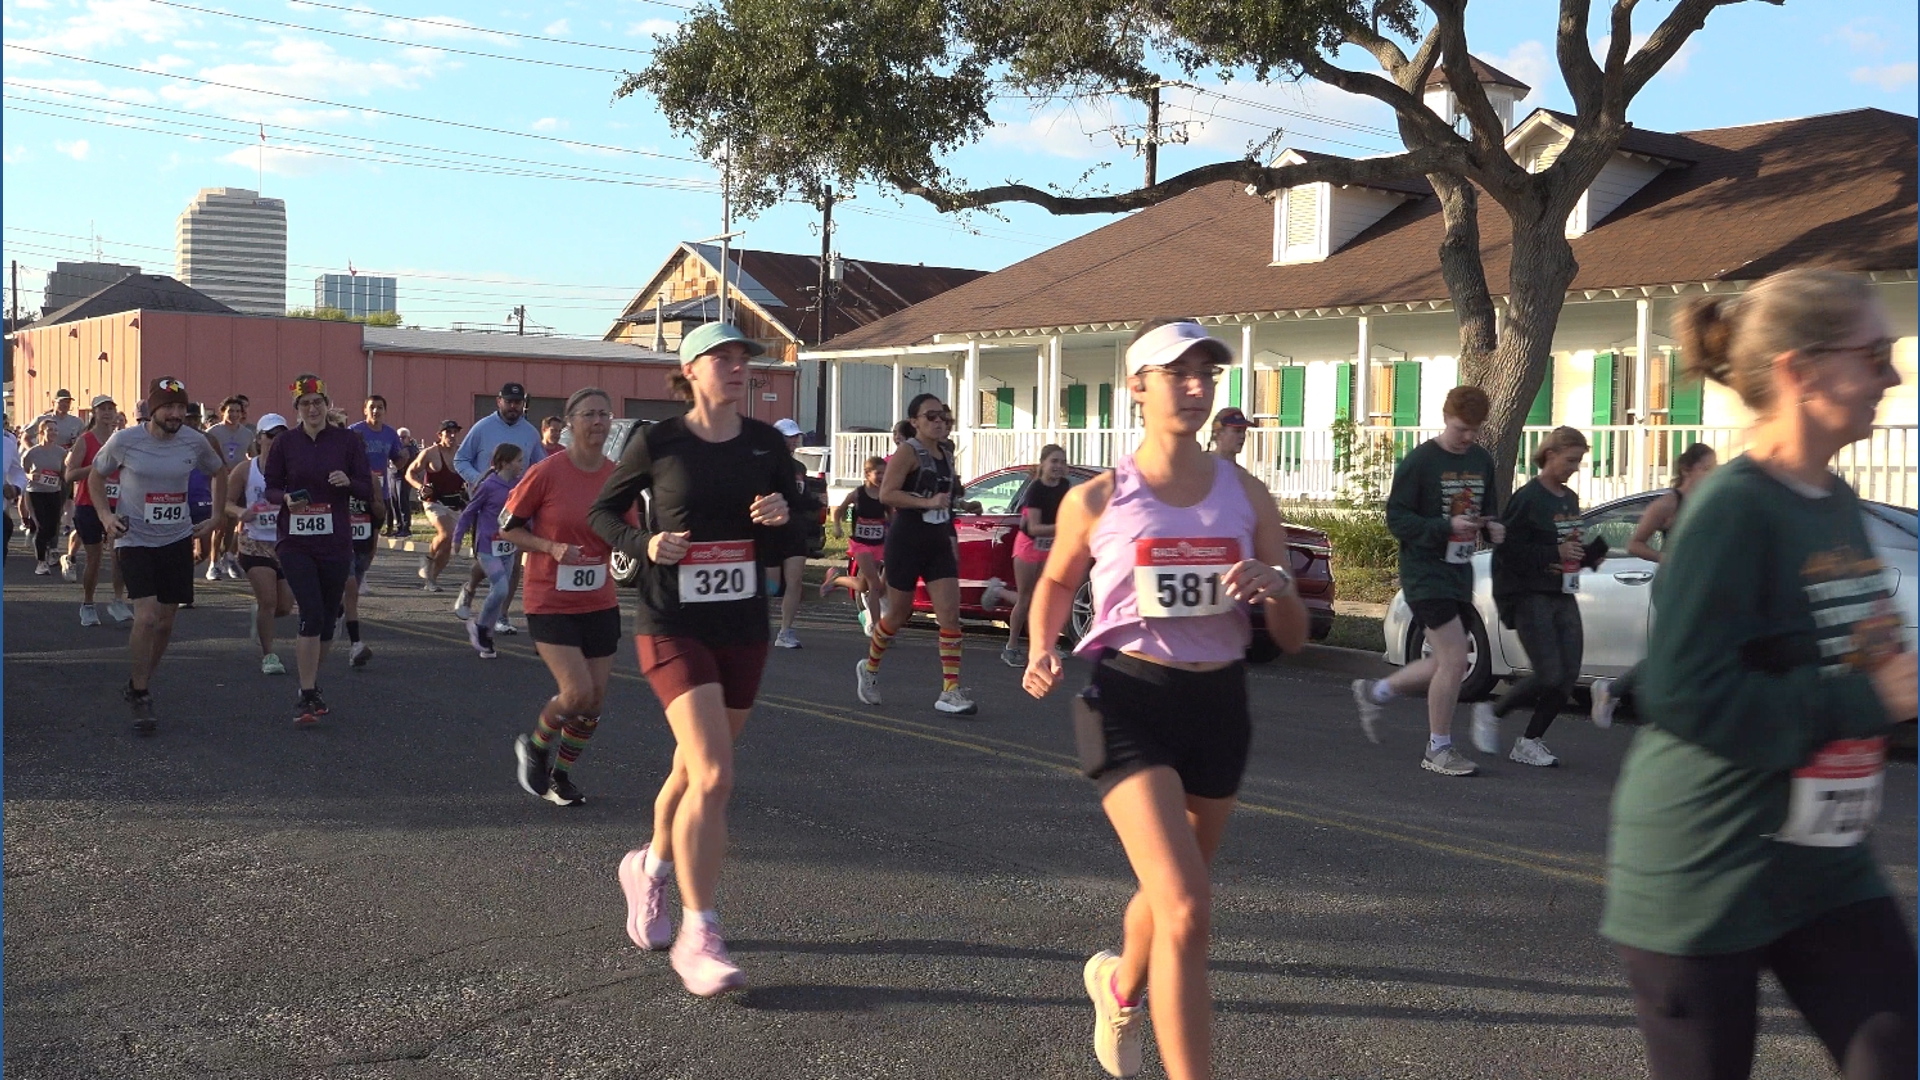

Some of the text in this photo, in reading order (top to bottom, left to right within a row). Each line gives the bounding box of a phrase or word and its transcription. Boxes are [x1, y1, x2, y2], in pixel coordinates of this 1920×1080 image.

[153, 506, 181, 521] 549
[296, 517, 325, 532] 548
[572, 569, 596, 587] 80
[694, 568, 745, 596] 320
[1156, 571, 1219, 608] 581
